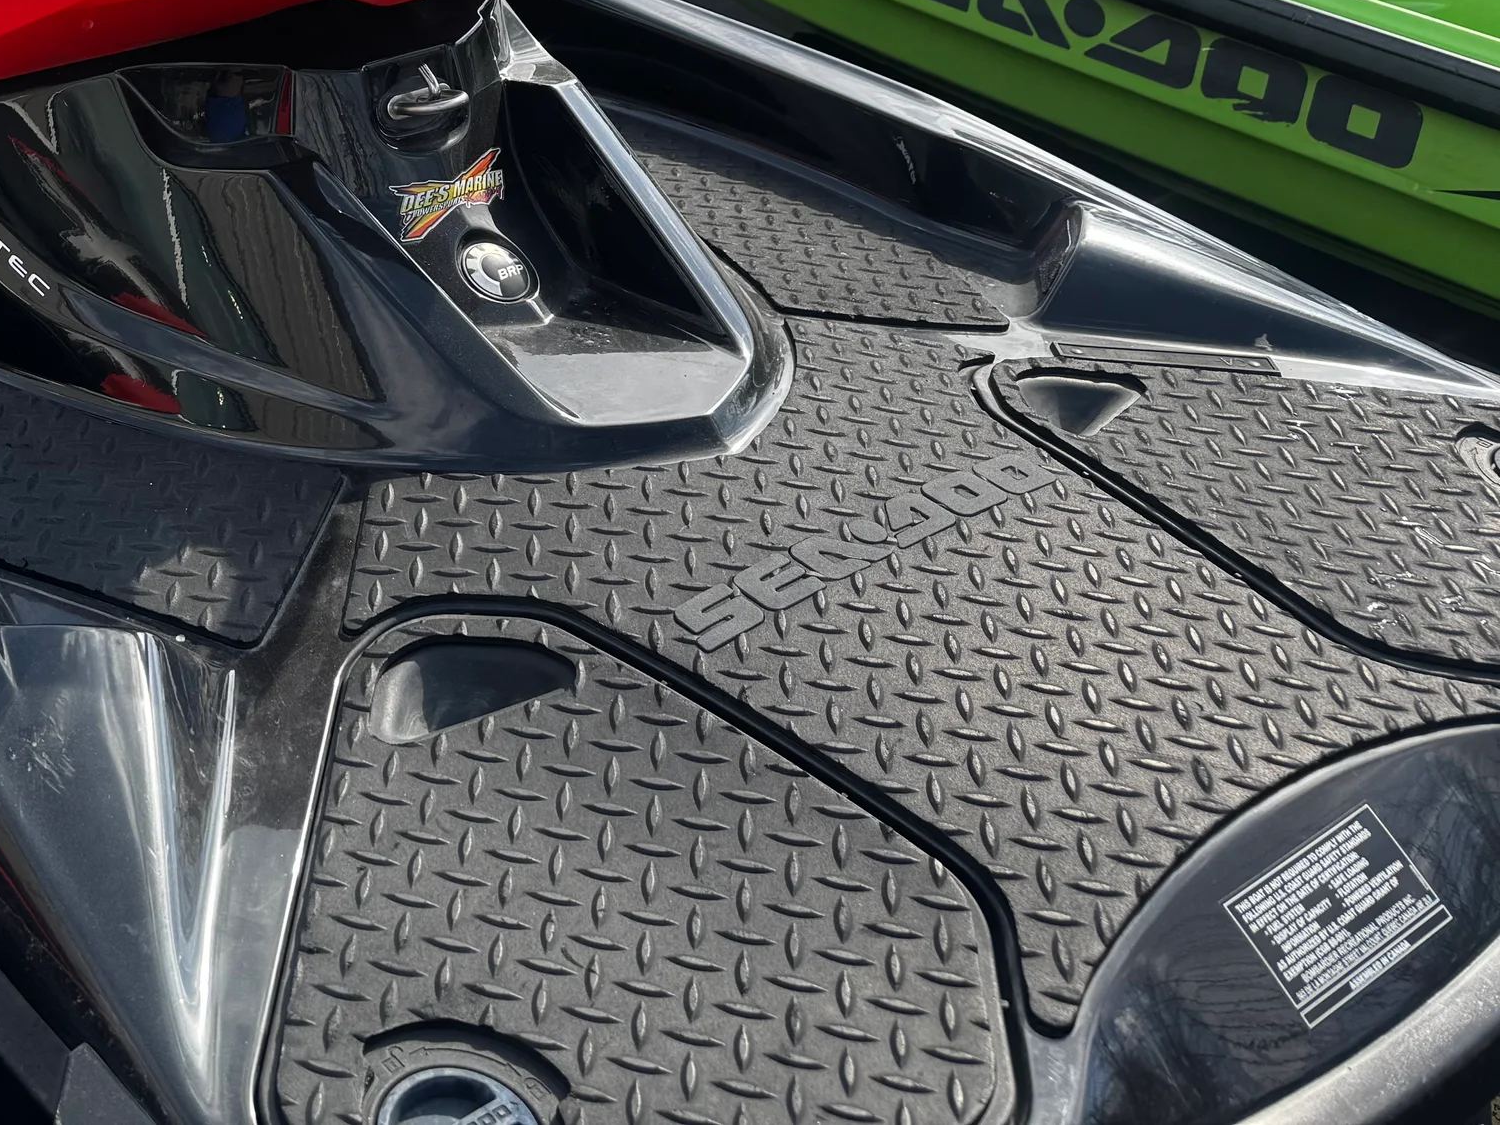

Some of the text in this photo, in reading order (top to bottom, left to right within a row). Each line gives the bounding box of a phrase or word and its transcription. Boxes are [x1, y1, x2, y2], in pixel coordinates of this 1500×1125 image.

[399, 183, 451, 214] DEE'S
[453, 169, 502, 199] MARINE
[497, 264, 524, 281] BRP
[1234, 820, 1363, 914] THIS BOAT IS NOT REQUIRED TO COMPLY WITH THE
[1241, 894, 1276, 923] FOLLOWING
[1283, 875, 1304, 894] COAST
[1301, 861, 1323, 881] GUARD
[1319, 848, 1342, 868] SAFETY
[1338, 827, 1371, 854] STANDARDS
[1329, 856, 1369, 888] SAFE LOADING
[1336, 871, 1368, 898] FLOTATION
[1343, 882, 1372, 906] POWERED
[1367, 859, 1403, 889] VENTILATION
[1248, 921, 1259, 933] IN
[1255, 907, 1279, 928] EFFECT
[1275, 900, 1288, 914] ON
[1284, 892, 1299, 907] THE
[1295, 882, 1313, 899] DATE
[1309, 877, 1321, 889] OF
[1265, 902, 1306, 935] FUEL SYSTEM
[1272, 897, 1333, 945] DISPLAY OF CAPACITY
[1275, 958, 1288, 972] AS
[1284, 933, 1322, 966] AUTHORIZED
[1317, 927, 1330, 941] BY
[1336, 906, 1358, 927] COAST
[1353, 893, 1376, 914] GUARD
[1371, 880, 1393, 900] GRANT
[1388, 875, 1400, 888] OF
[1280, 919, 1321, 953] INFORMATION
[1300, 949, 1340, 983] BOMBARDIER
[1336, 920, 1379, 956] RECREATIONAL
[1374, 899, 1406, 927] PRODUCTS
[1282, 951, 1318, 982] EXEMPTION
[1347, 937, 1411, 991] ASSEMBLED IN CANADA
